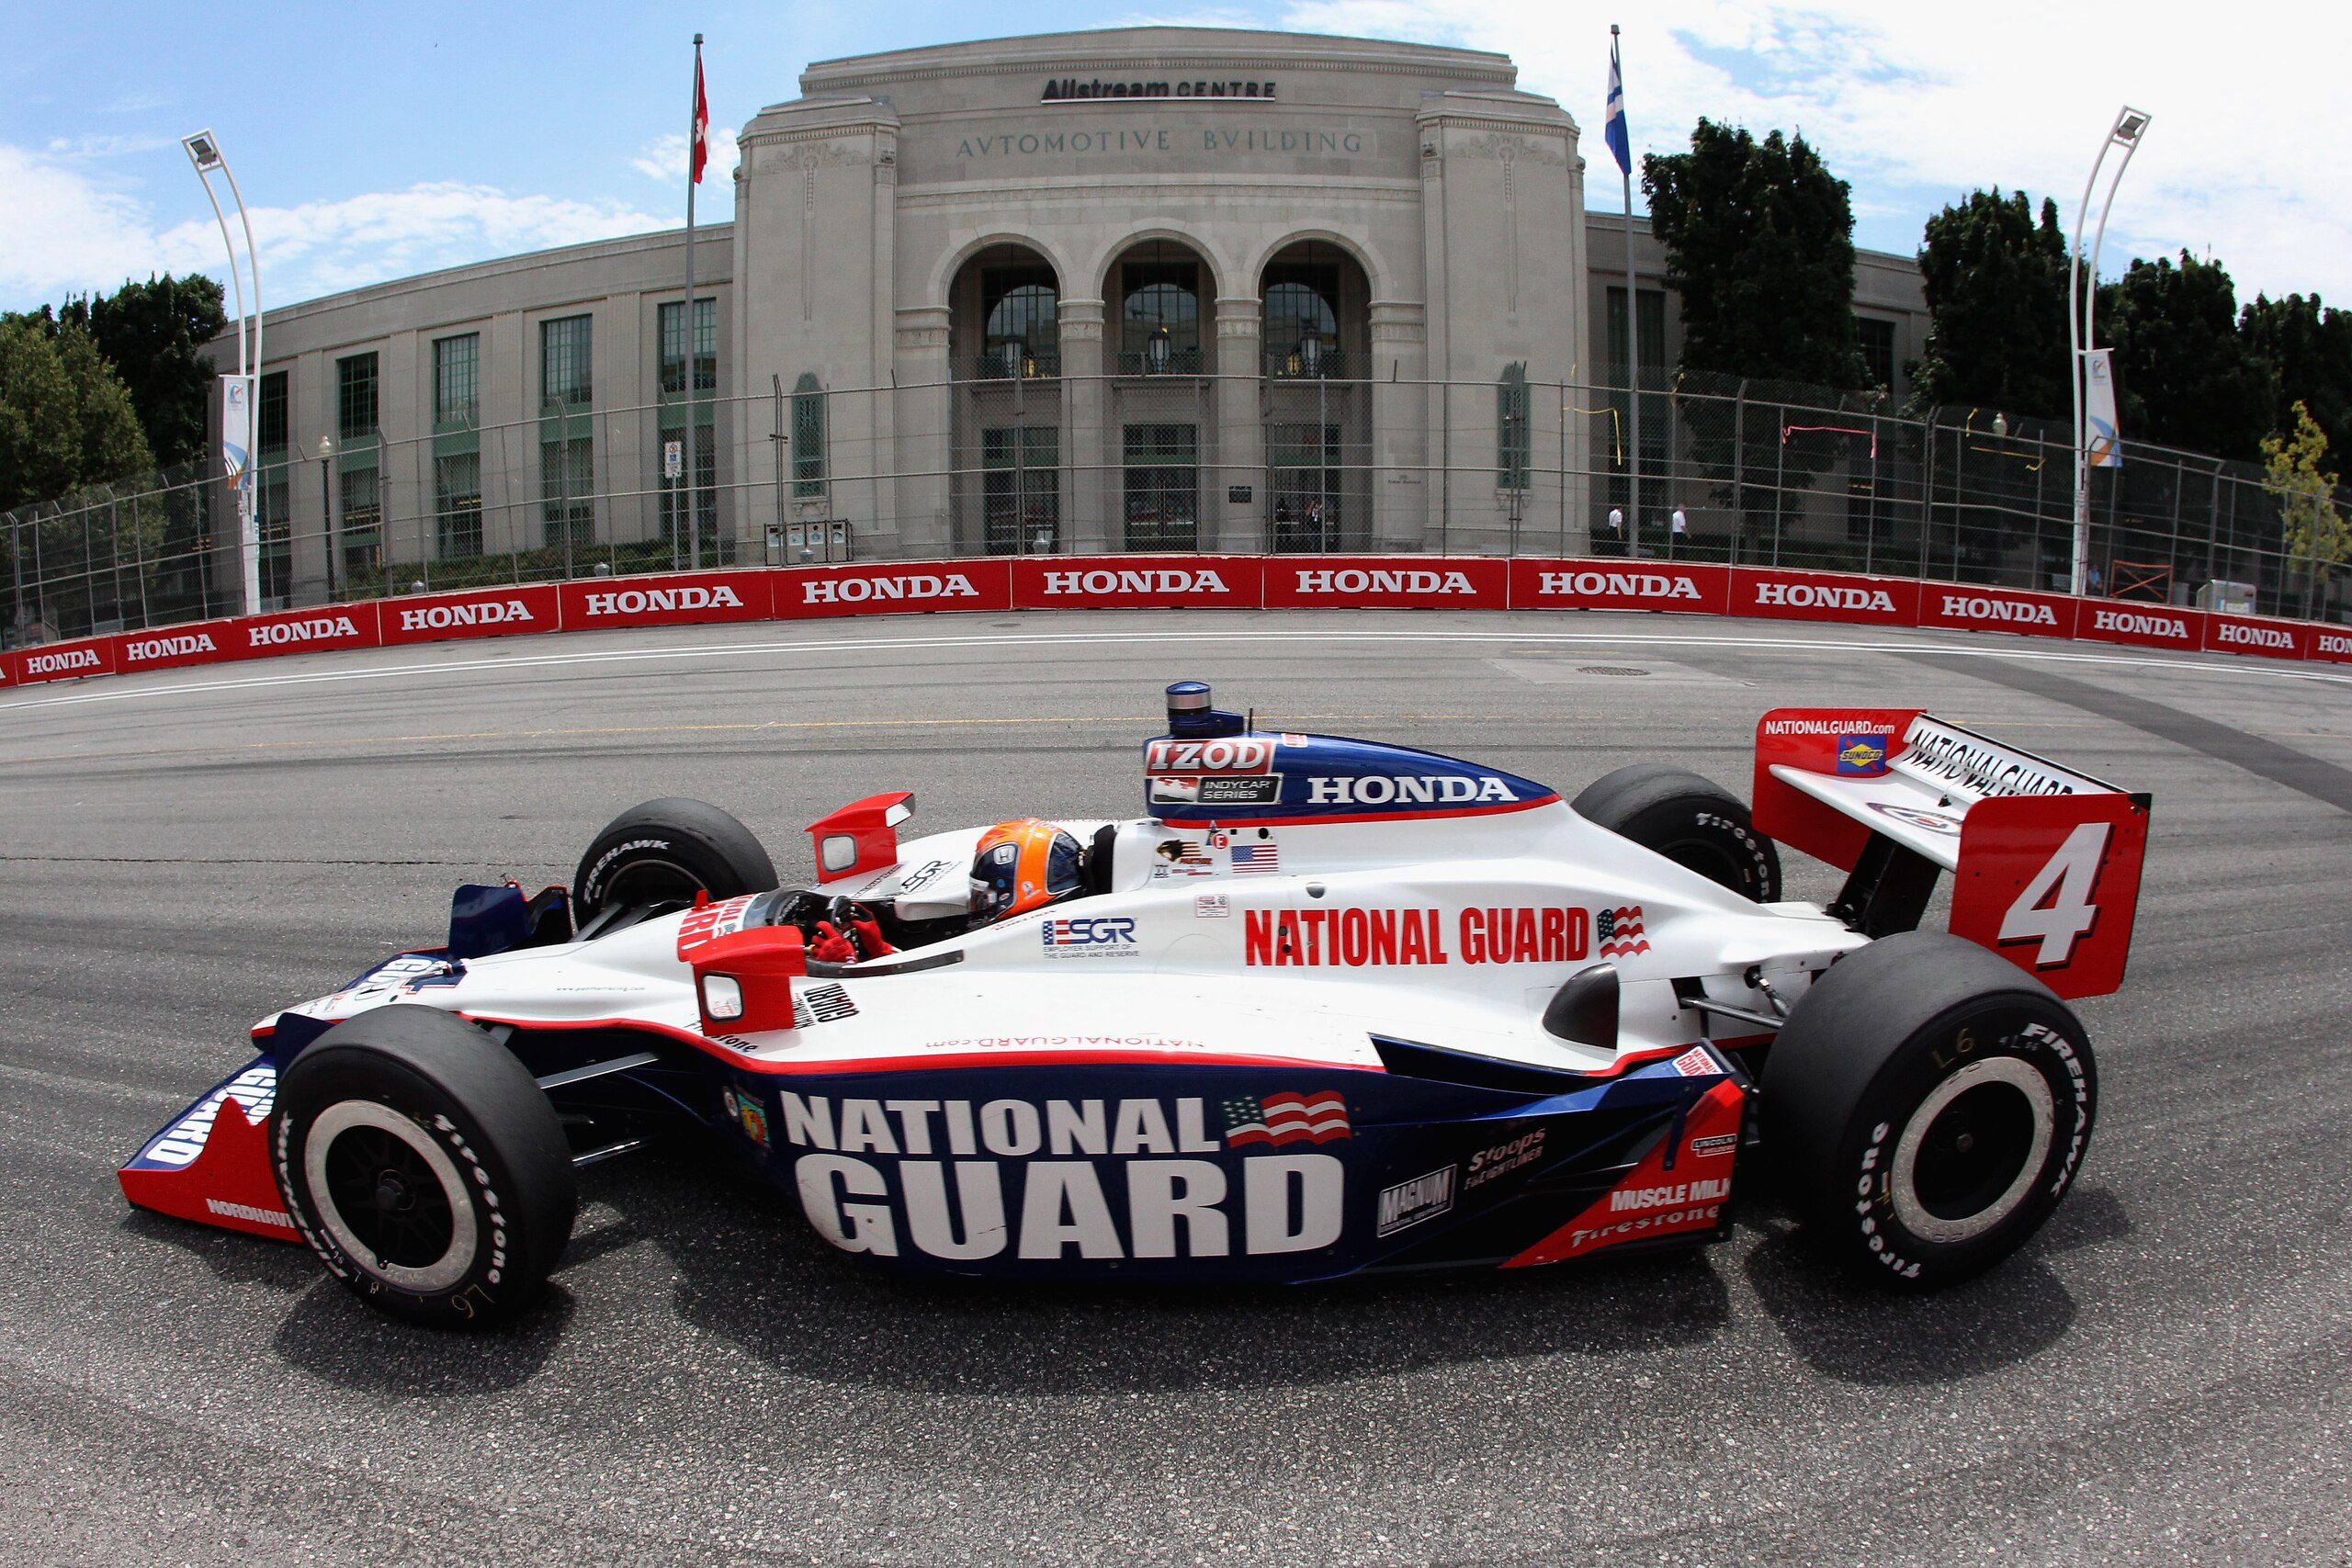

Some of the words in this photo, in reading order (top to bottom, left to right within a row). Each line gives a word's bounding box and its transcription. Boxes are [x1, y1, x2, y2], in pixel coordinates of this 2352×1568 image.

[1042, 78, 1170, 100] Allstream
[1176, 81, 1276, 98] CENTRE
[956, 130, 1170, 157] AVTOMOTIVE
[1203, 130, 1362, 152] BVILDING
[802, 575, 978, 603] HONDA
[1044, 570, 1229, 594] HONDA
[1296, 570, 1476, 594] HONDA
[1539, 573, 1701, 599] HONDA
[585, 586, 743, 615] HONDA
[1756, 583, 1895, 611] HONDA
[1941, 596, 2057, 625] HONDA
[401, 600, 533, 631] HONDA
[2094, 610, 2188, 638] HONDA
[249, 616, 358, 647] HONDA
[2219, 624, 2294, 649] HONDA
[27, 649, 101, 674] HONDA
[127, 633, 216, 661] HONDA
[1765, 720, 1894, 735] NATIONALGUARD.com
[1150, 741, 1265, 770] IZOD
[1841, 750, 1882, 761] SUNOCO
[1203, 790, 1259, 800] SERIES
[1204, 780, 1269, 790] INDYCAR
[1307, 776, 1520, 805] HONDA
[1695, 812, 1770, 903] Fireston
[1996, 821, 2116, 965] 4
[1245, 907, 1449, 967] NATIONAL
[1460, 907, 1589, 965] GUARD
[802, 982, 860, 1023] GUARD
[779, 1089, 1220, 1156] NATIONAL
[2021, 1021, 2089, 1197] FIREHAWK
[1467, 1127, 1546, 1172] Stoops
[1694, 1135, 1735, 1148] LINCOLN
[1463, 1145, 1544, 1191] FREIGHTLINER
[434, 1112, 507, 1285] Firestone
[794, 1154, 1345, 1259] GUARD
[1381, 1168, 1452, 1225] MAGNUM
[1610, 1183, 1687, 1213] MUSCLE
[1853, 1120, 1922, 1279] Firestone
[1571, 1204, 1720, 1248] Firestone
